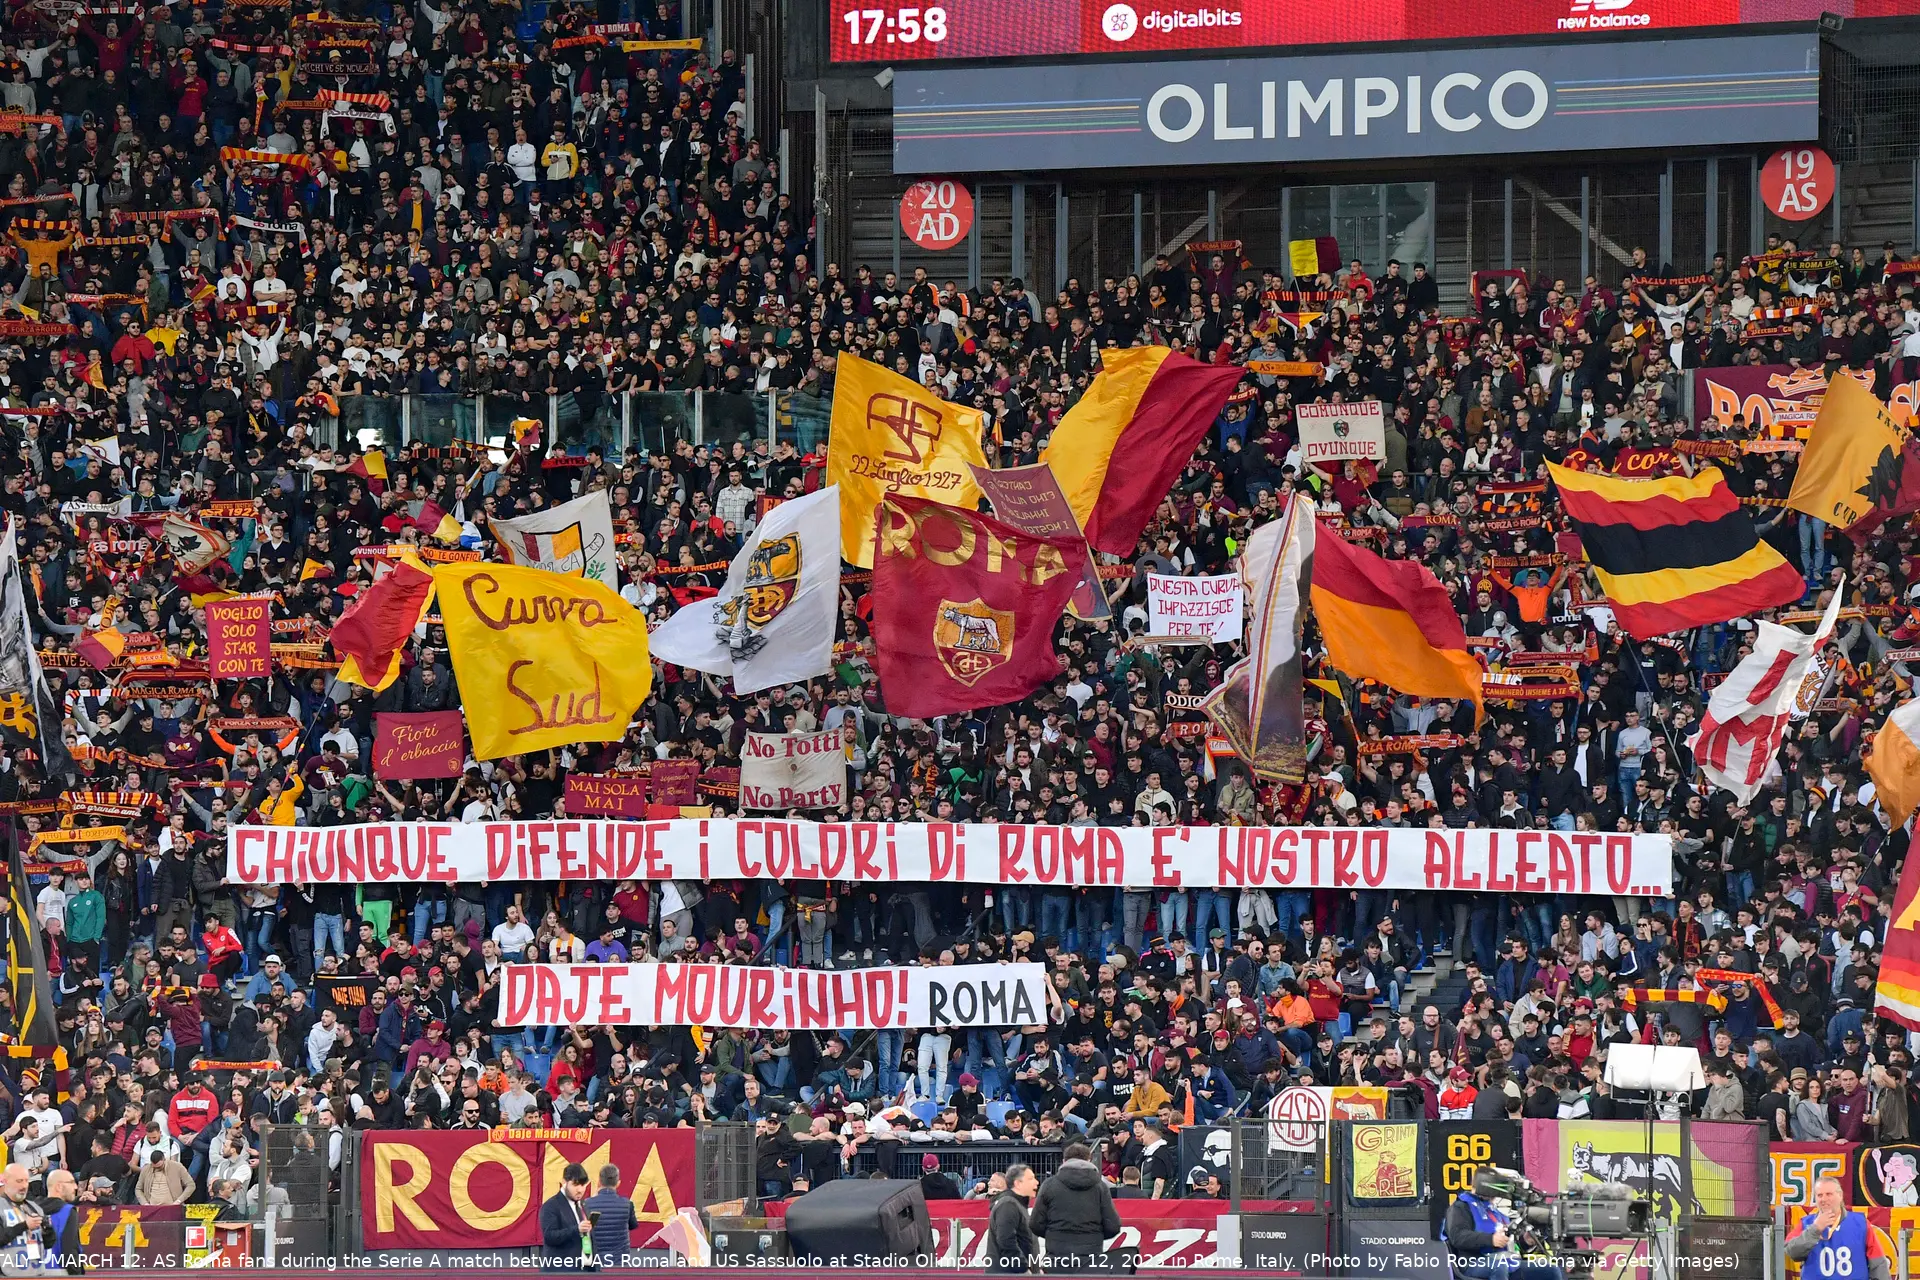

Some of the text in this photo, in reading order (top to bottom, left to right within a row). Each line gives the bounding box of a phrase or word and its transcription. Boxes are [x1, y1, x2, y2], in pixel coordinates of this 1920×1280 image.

[595, 21, 630, 33] AS ROMA
[843, 7, 947, 44] 17:58
[1142, 8, 1242, 37] digitalbits
[1557, 12, 1650, 29] new balance
[1146, 69, 1549, 143] OLIMPICO
[1779, 150, 1813, 178] 19
[920, 182, 956, 210] 20
[1776, 182, 1817, 214] AS
[268, 220, 297, 230] roma
[916, 214, 960, 242] AD
[1799, 261, 1823, 270] ROMA
[1634, 274, 1707, 286] LAZIO MERDA
[1785, 297, 1809, 306] ROMA
[40, 326, 61, 334] ROMA
[1300, 401, 1379, 418] COMUNQUE
[1307, 441, 1376, 457] OVUNQUE
[850, 454, 961, 492] 22 Luglio 1927
[66, 502, 83, 510] AS
[1425, 516, 1456, 525] ROMA
[1487, 521, 1511, 530] FORZA
[1351, 528, 1372, 537] ROMA
[93, 541, 108, 552] as
[438, 550, 447, 560] TE
[658, 561, 726, 574] LAZIO MERDA
[1149, 579, 1241, 593] QUESTA CURVA
[463, 573, 618, 631] Curva
[1157, 597, 1234, 615] IMPAZZISCE
[212, 606, 263, 621] VOGLIO
[1552, 613, 1582, 623] roma
[222, 624, 256, 639] SOLO
[1168, 621, 1194, 637] PER
[223, 642, 257, 656] STAR
[44, 655, 61, 667] CHI
[65, 655, 77, 666] VE
[218, 656, 264, 673] CON TE
[131, 687, 195, 696] MAGICA ROMA
[508, 660, 616, 735] Sud
[1525, 685, 1551, 696] INSIEME
[1552, 686, 1558, 695] A
[1559, 685, 1567, 695] TE
[1167, 694, 1202, 707] ODIO
[391, 724, 438, 745] Fiori
[746, 729, 840, 759] No Totti
[1386, 737, 1417, 750] ROMA
[569, 779, 640, 796] MAI SOLA
[742, 782, 842, 809] No Party
[87, 804, 120, 816] grande
[584, 794, 624, 811] MAI
[999, 824, 1125, 885] ROMA
[1151, 827, 1191, 887] E'
[1218, 827, 1390, 887] NOSTRO
[1423, 830, 1662, 895] ALLEATO...
[332, 987, 350, 1004] DAJE
[505, 965, 632, 1026] DAJE
[929, 978, 1036, 1026] ROMA
[508, 1128, 572, 1139] Daje Mauro!
[1355, 1125, 1416, 1152] GRINTA
[1447, 1133, 1492, 1161] 66
[373, 1140, 678, 1234] ROMA
[1266, 1231, 1287, 1240] OLIMPICO
[1360, 1237, 1425, 1245] STADIO OLIMPICO
[1819, 1246, 1853, 1277] 08
